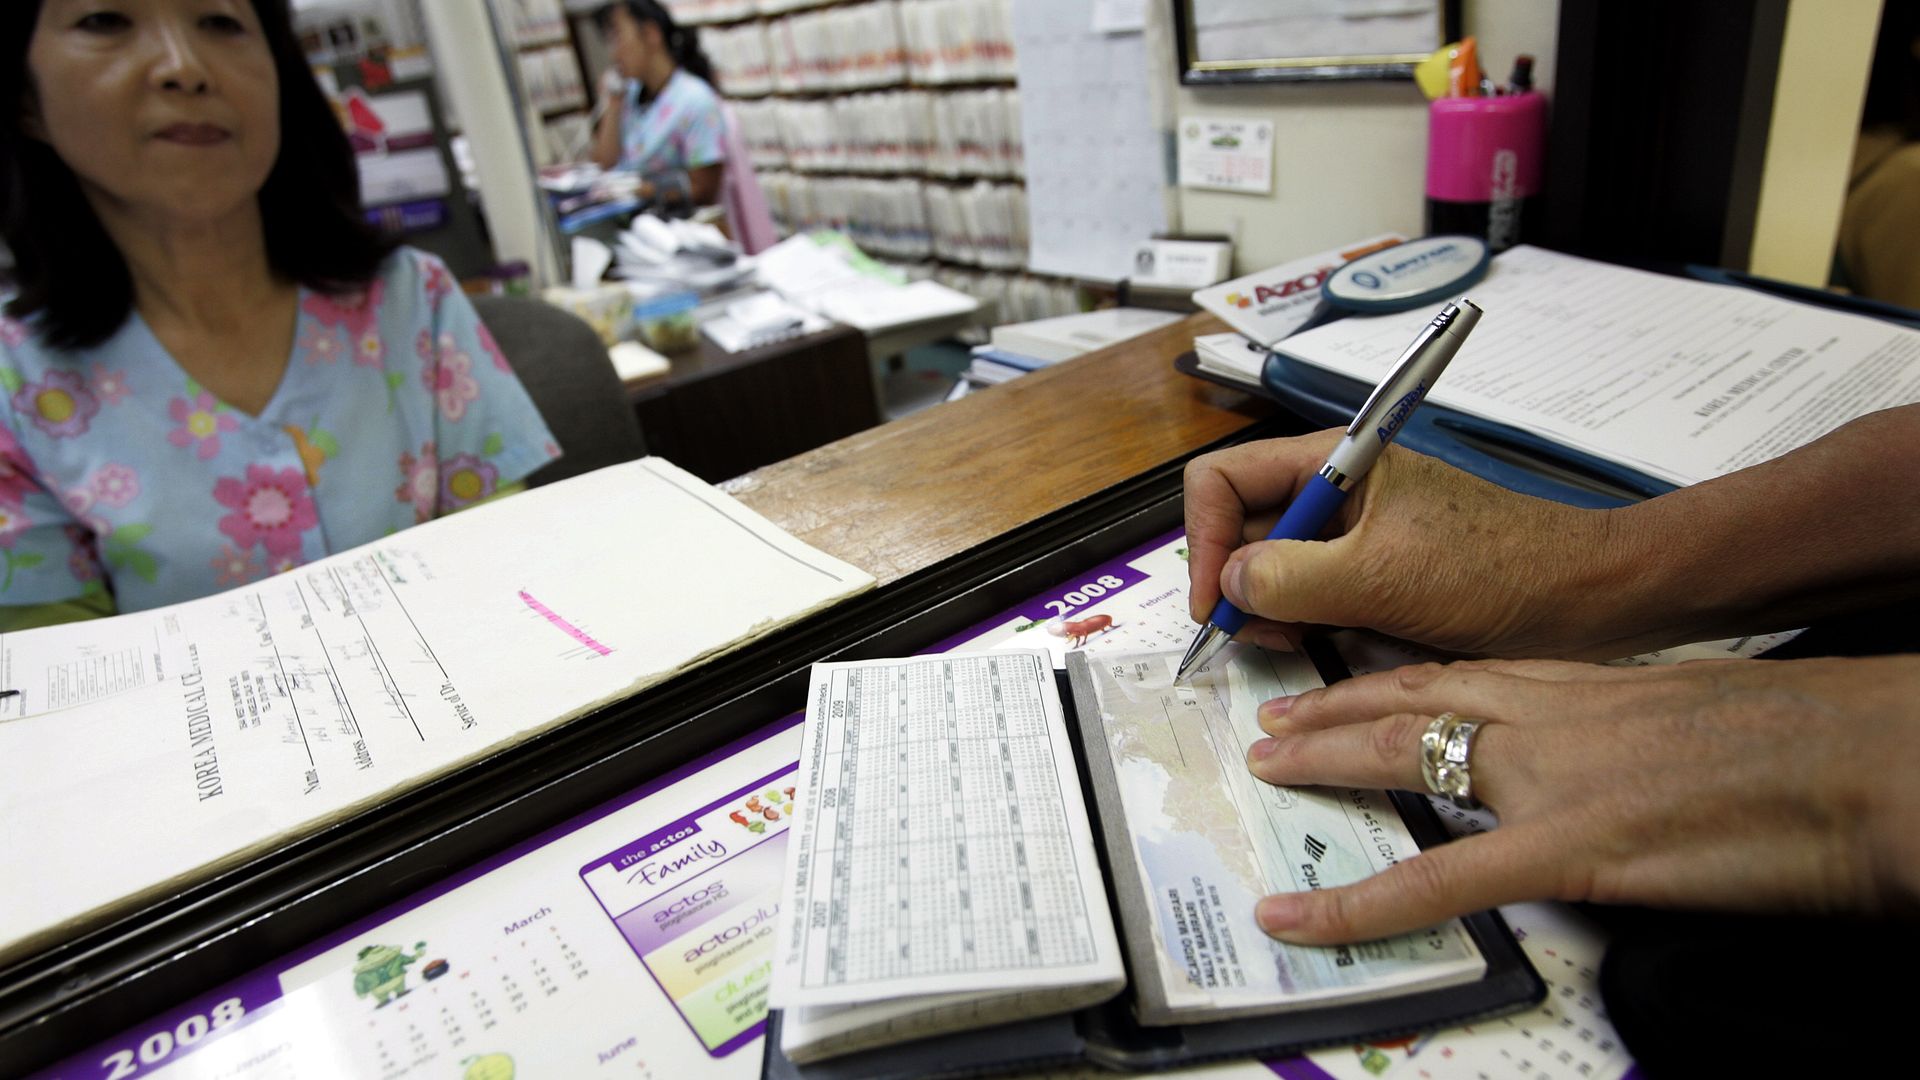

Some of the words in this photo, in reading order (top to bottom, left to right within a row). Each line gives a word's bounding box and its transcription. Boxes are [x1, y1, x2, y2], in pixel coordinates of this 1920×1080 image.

[1044, 574, 1124, 617] 2008
[1139, 586, 1181, 610] February
[184, 686, 213, 748] MEDICAL
[454, 703, 478, 731] Service
[194, 746, 223, 802] KOREA
[353, 739, 374, 770] Address
[304, 769, 321, 795] Name
[811, 901, 828, 929] 2007
[823, 787, 837, 809] 2008
[832, 700, 845, 719] 2009
[620, 850, 647, 867] the
[650, 826, 694, 853] actos
[626, 839, 727, 886] Family
[1302, 863, 1320, 890] rica
[503, 906, 552, 935] March
[653, 880, 724, 924] actos
[102, 997, 246, 1080] 2008
[598, 1037, 637, 1065] June
